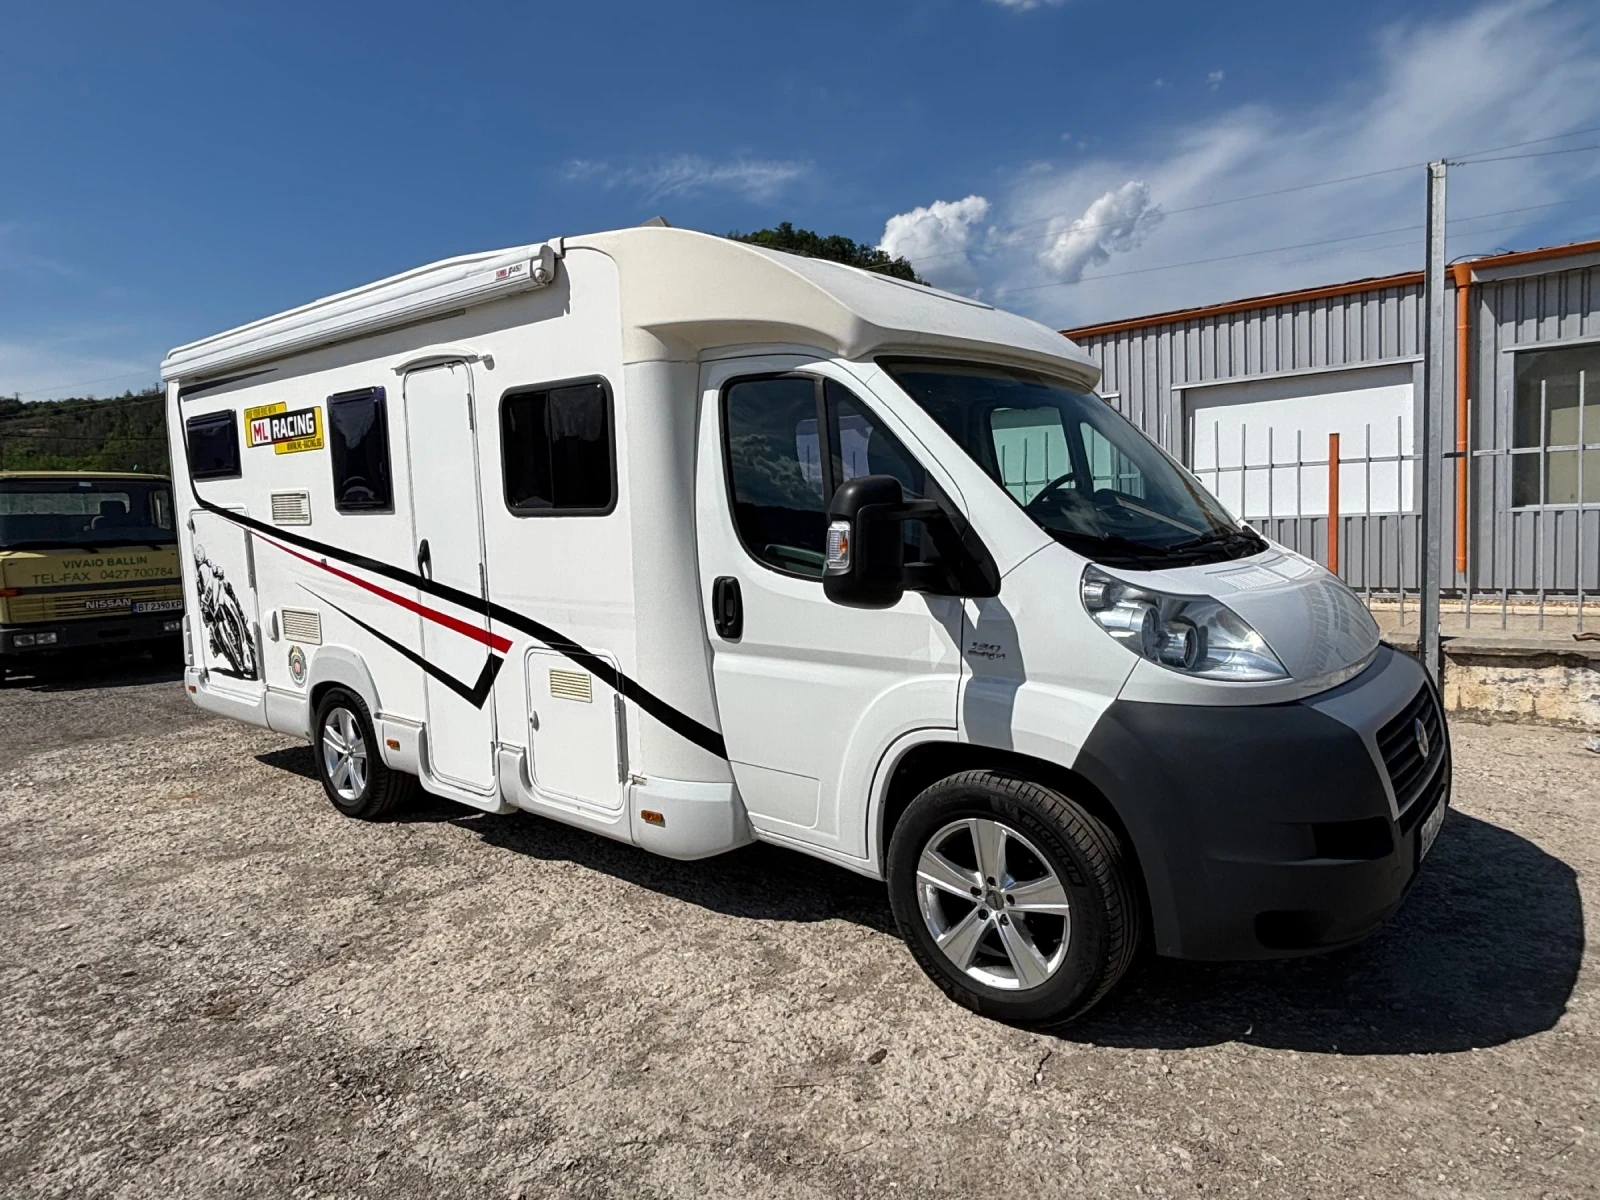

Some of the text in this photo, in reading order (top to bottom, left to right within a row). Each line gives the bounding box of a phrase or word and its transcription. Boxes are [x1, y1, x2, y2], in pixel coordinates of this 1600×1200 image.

[253, 422, 268, 442] ML
[272, 412, 314, 439] RACING
[62, 556, 148, 569] VIVAIO BALLIN
[32, 572, 91, 585] TEL-FAX
[85, 598, 132, 609] NISSAN
[1021, 815, 1086, 887] MICHELIN
